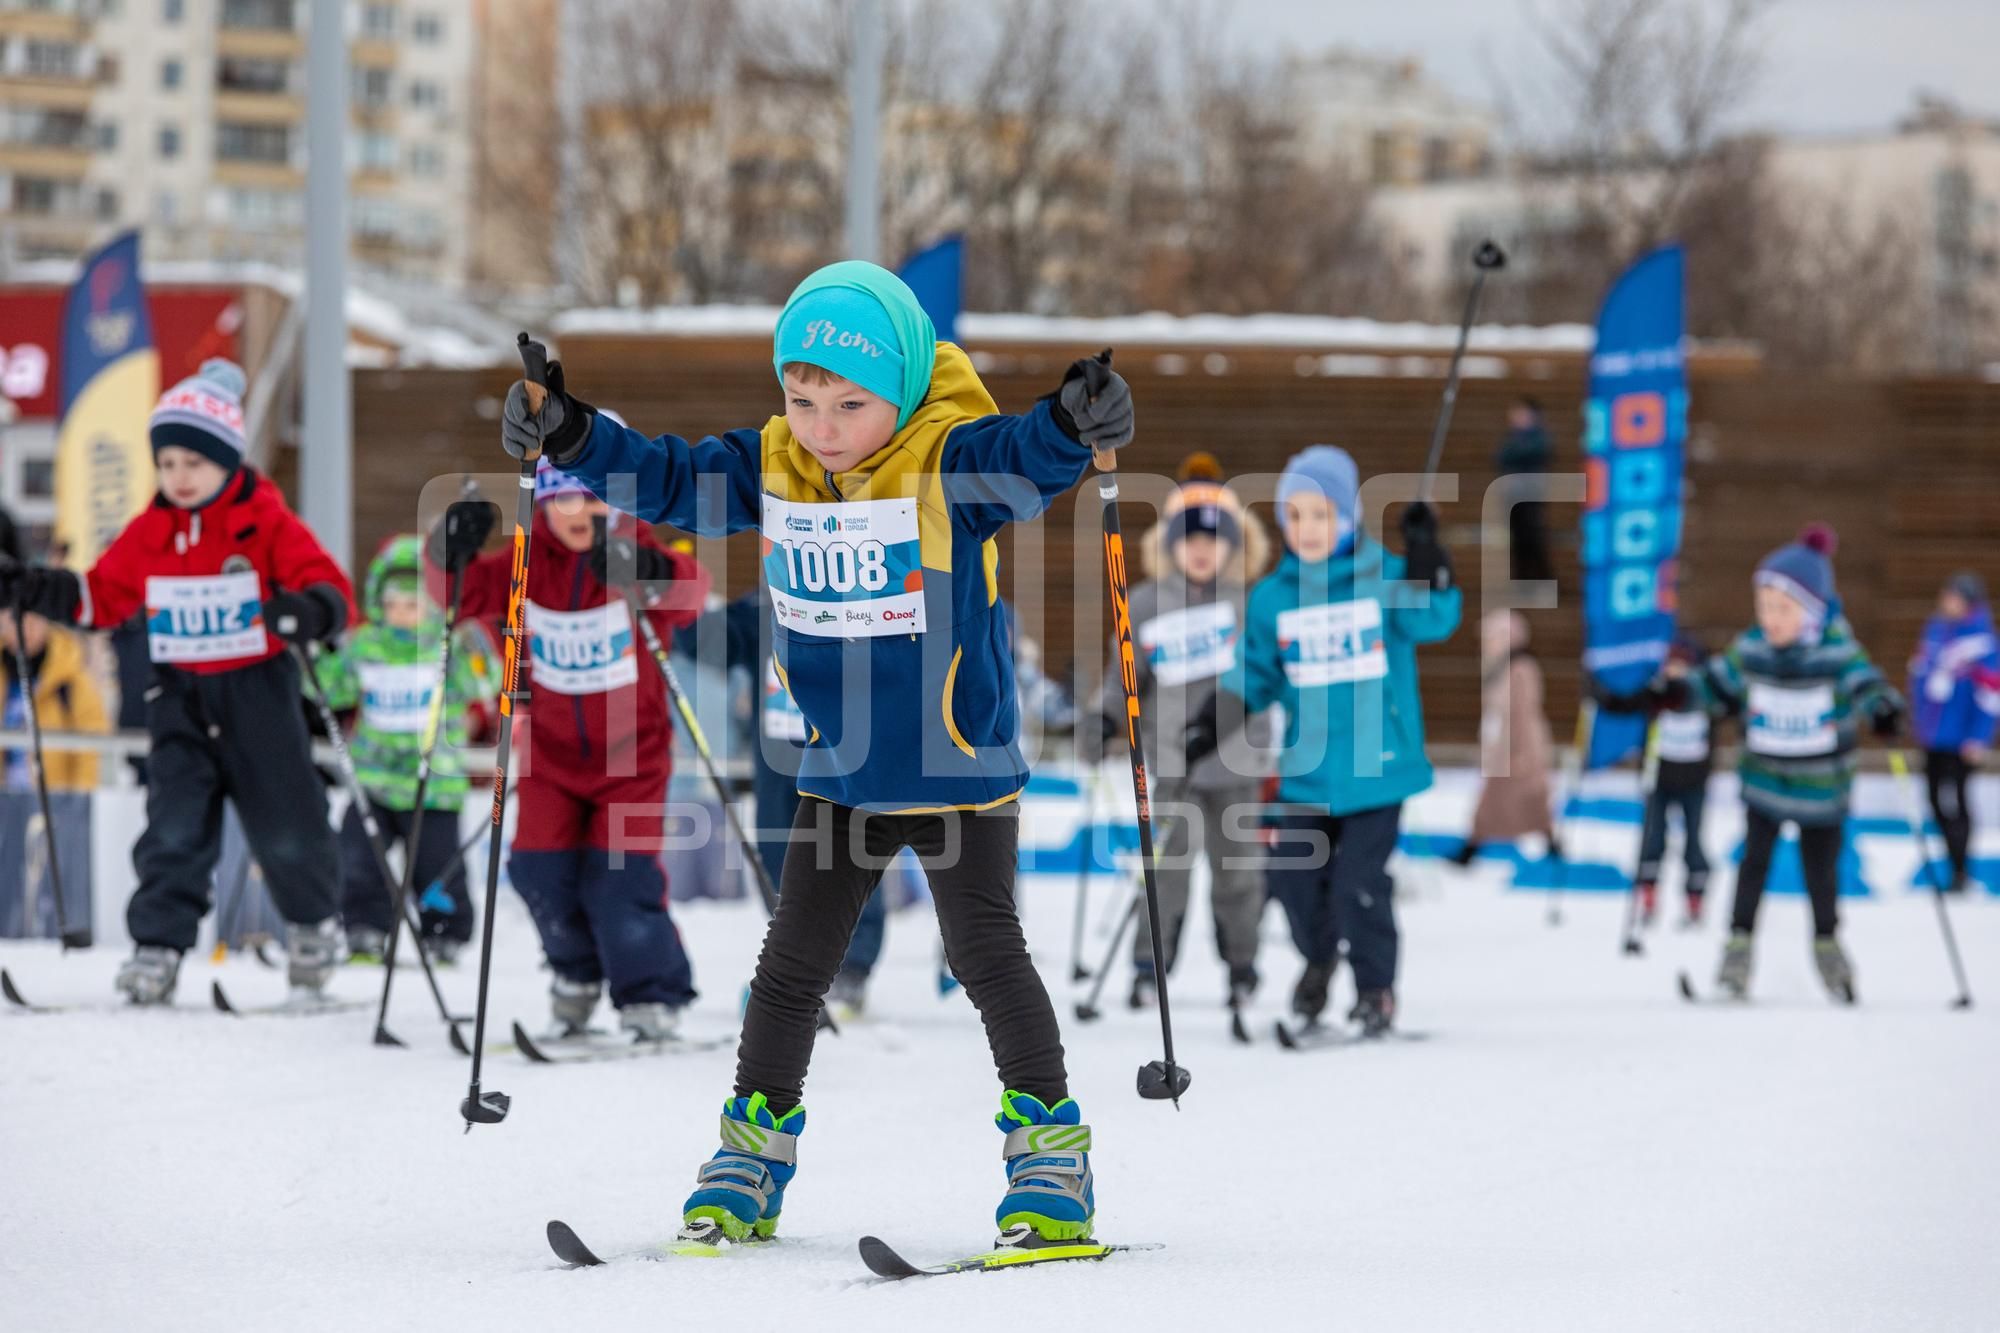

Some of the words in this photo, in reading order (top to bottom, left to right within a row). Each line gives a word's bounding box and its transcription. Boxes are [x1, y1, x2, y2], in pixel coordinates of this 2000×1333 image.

[802, 319, 884, 358] grom
[844, 516, 869, 525] РОДНЫЕ
[845, 524, 868, 532] ГОРОДА
[782, 539, 888, 592] 1008
[168, 602, 243, 635] 1012
[846, 610, 874, 625] Bitey
[541, 635, 614, 668] 1003
[1109, 532, 1140, 750] EXEL
